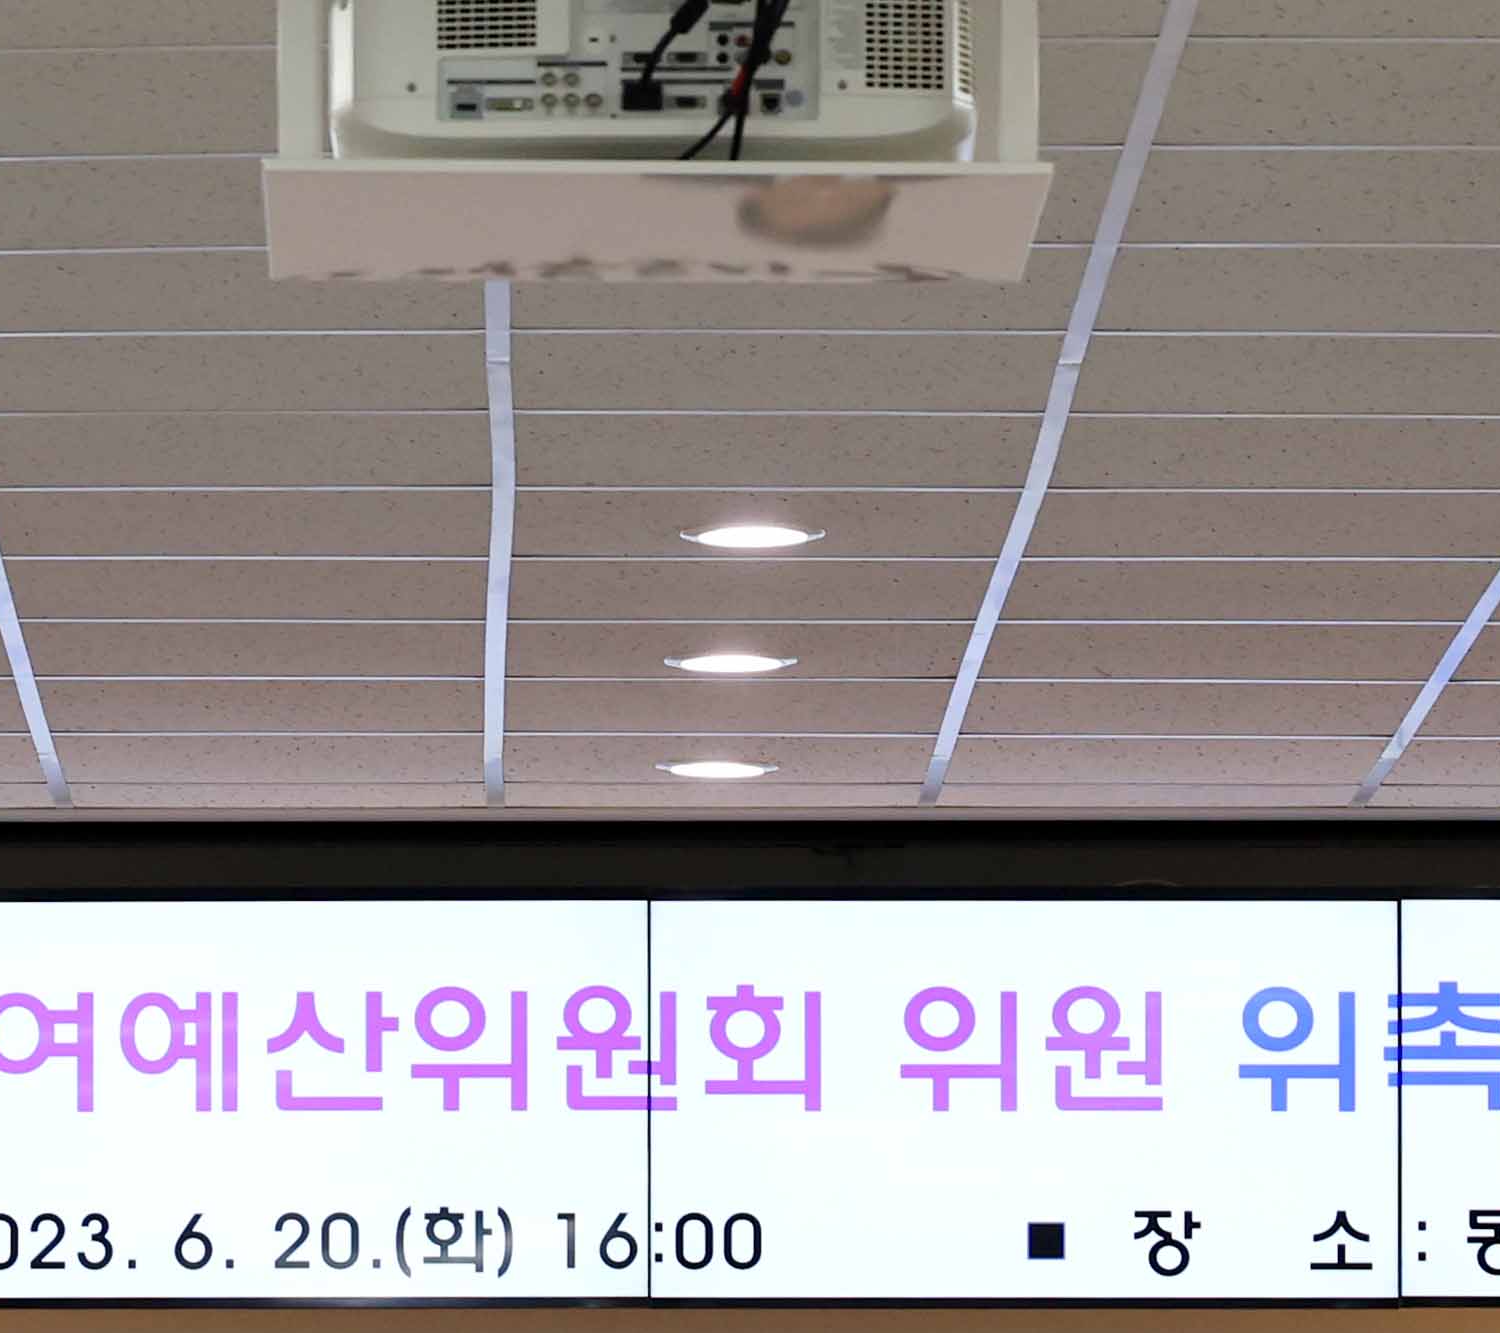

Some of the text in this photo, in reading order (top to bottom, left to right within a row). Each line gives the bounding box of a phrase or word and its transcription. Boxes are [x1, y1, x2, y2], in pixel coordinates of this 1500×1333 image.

[898, 984, 1165, 1113] 위원
[173, 1212, 235, 1271] 6.
[273, 1205, 513, 1278] 20.(화)
[556, 1211, 763, 1271] 16:00
